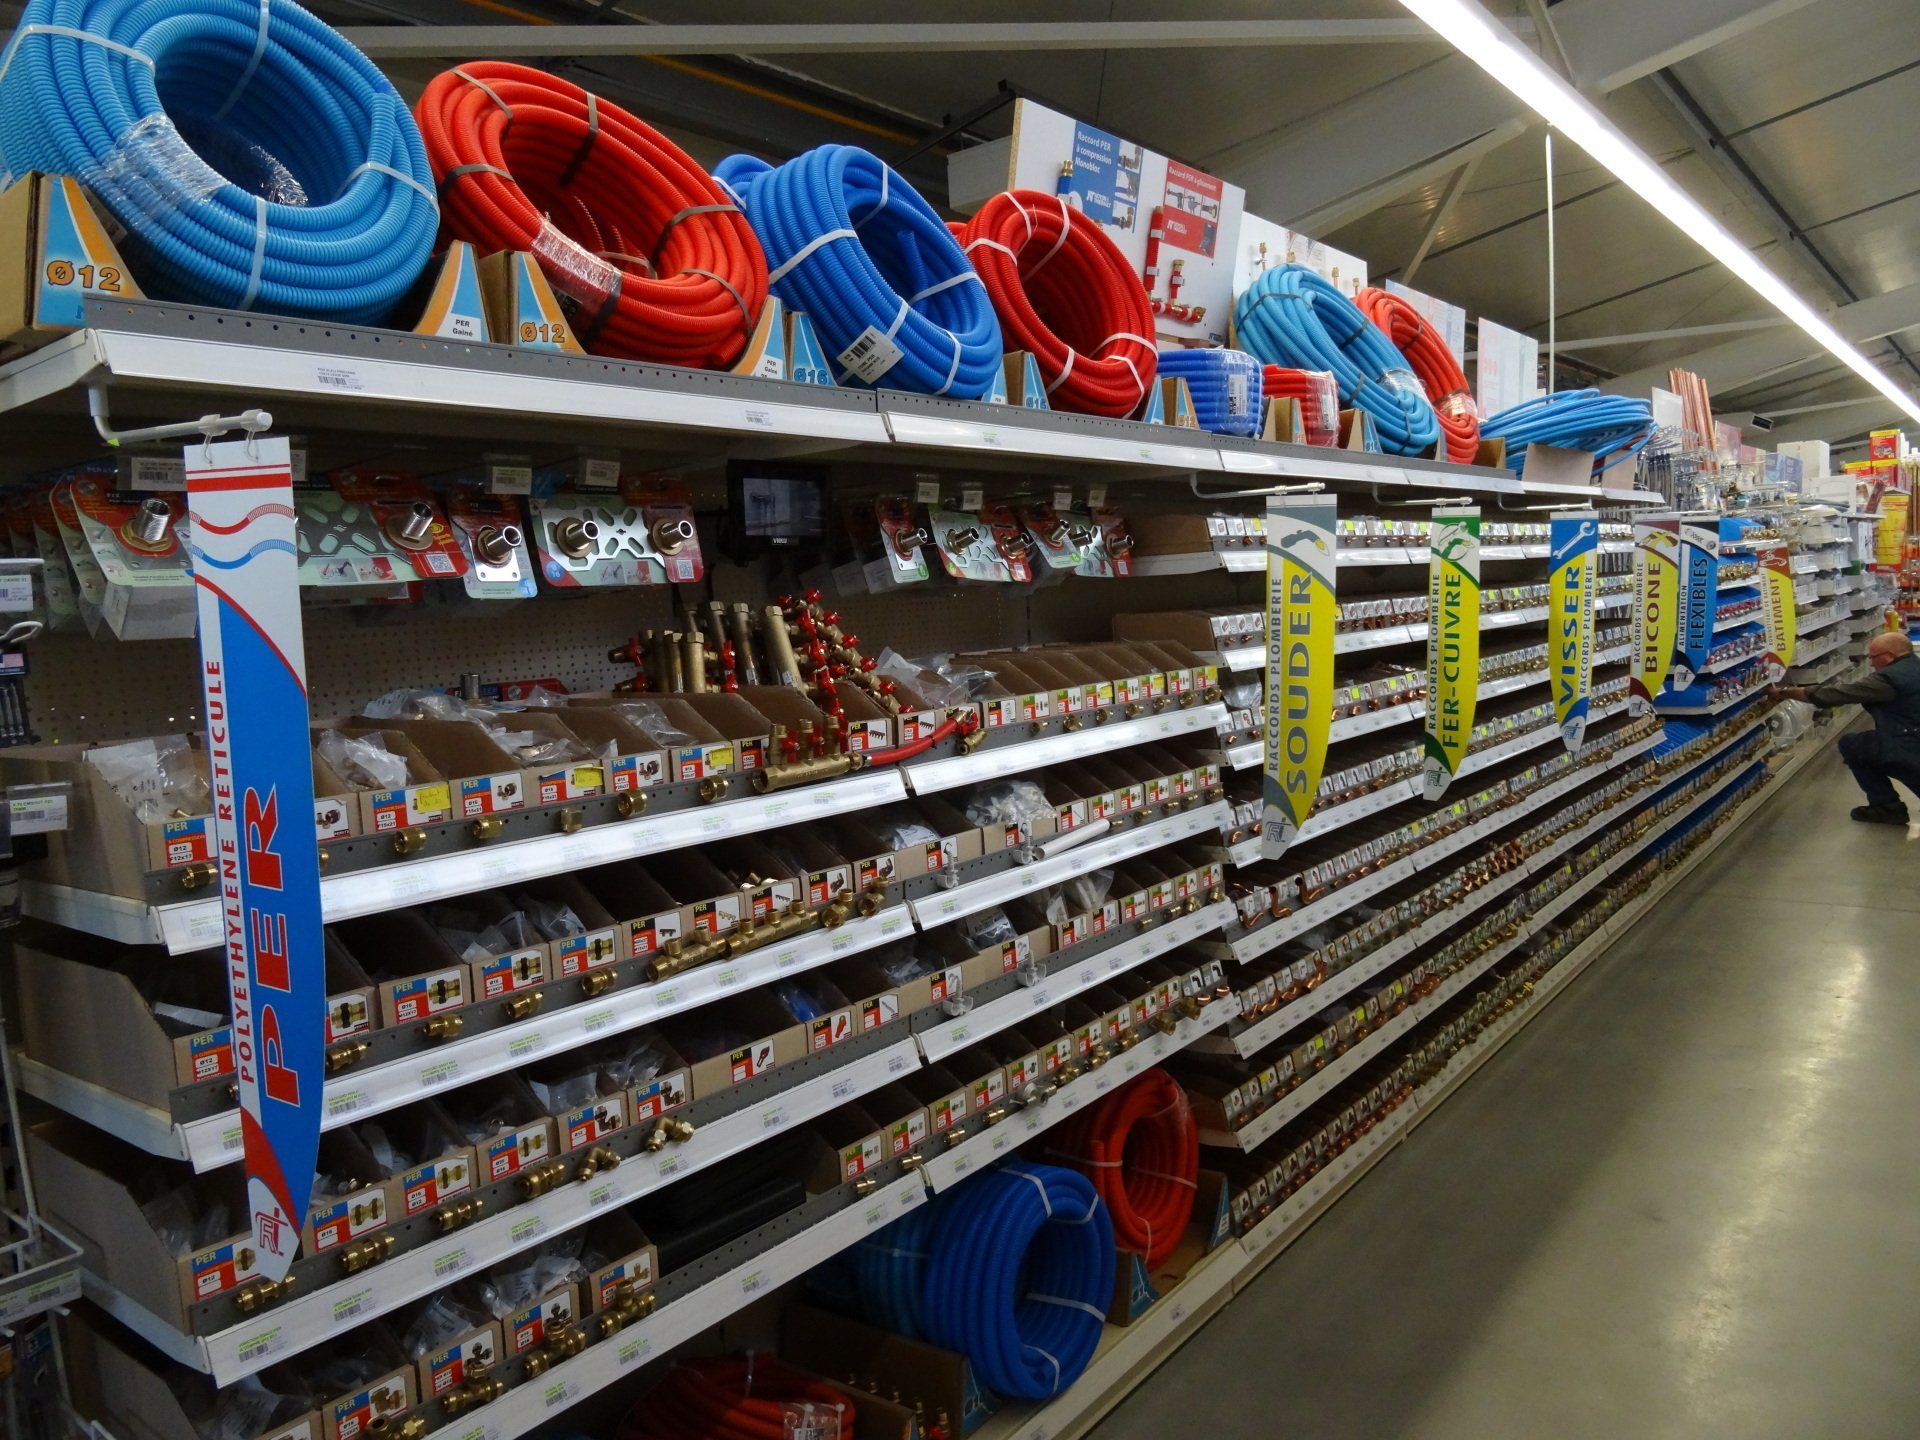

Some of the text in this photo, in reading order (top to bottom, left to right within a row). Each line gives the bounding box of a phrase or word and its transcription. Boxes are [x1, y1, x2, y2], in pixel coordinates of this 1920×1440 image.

[1078, 131, 1111, 152] Raccord PER
[1080, 147, 1112, 165] compression
[46, 260, 121, 292] Ø12
[455, 319, 470, 328] PER
[452, 327, 473, 337] Gainé
[520, 321, 565, 343] Ø12
[794, 368, 828, 385] Ø16
[1690, 558, 1708, 649] FLEXIBLES
[1633, 562, 1644, 663] RACCORDS PLOMBERIE
[1644, 562, 1661, 673] BICONE
[1678, 584, 1688, 646] ALIMENTATION
[1770, 577, 1786, 652] BATIMENT
[1558, 566, 1581, 707] VISSER
[1579, 565, 1594, 694] RACCORDS PLOMBERIE
[1428, 574, 1440, 730] RACCORDS PLOMBERIE
[1442, 574, 1461, 749] FER-CUIVRE
[1268, 578, 1282, 771] RACCORDS PLOMBERIE
[1286, 570, 1313, 795] SOUDER
[682, 749, 693, 757] PER
[613, 758, 626, 767] PER
[463, 780, 478, 789] PER
[375, 792, 392, 802] PER
[166, 821, 188, 832] PER
[206, 660, 255, 1083] POLYETHYLENE RETICULE
[695, 904, 707, 912] PER
[632, 922, 645, 930] PER
[243, 782, 300, 1107] PER
[561, 940, 576, 950] PER
[396, 982, 414, 992] PER
[193, 1035, 214, 1048] PER
[732, 1050, 744, 1060] PER
[638, 1087, 650, 1097] PER
[570, 1112, 584, 1122] PER
[490, 1139, 506, 1150] PER
[406, 1172, 422, 1182] PER
[315, 1208, 334, 1220] PER
[196, 1252, 216, 1266] PER
[202, 1275, 215, 1283] Ø12
[432, 1352, 448, 1366] PER
[337, 1399, 355, 1414] PER
